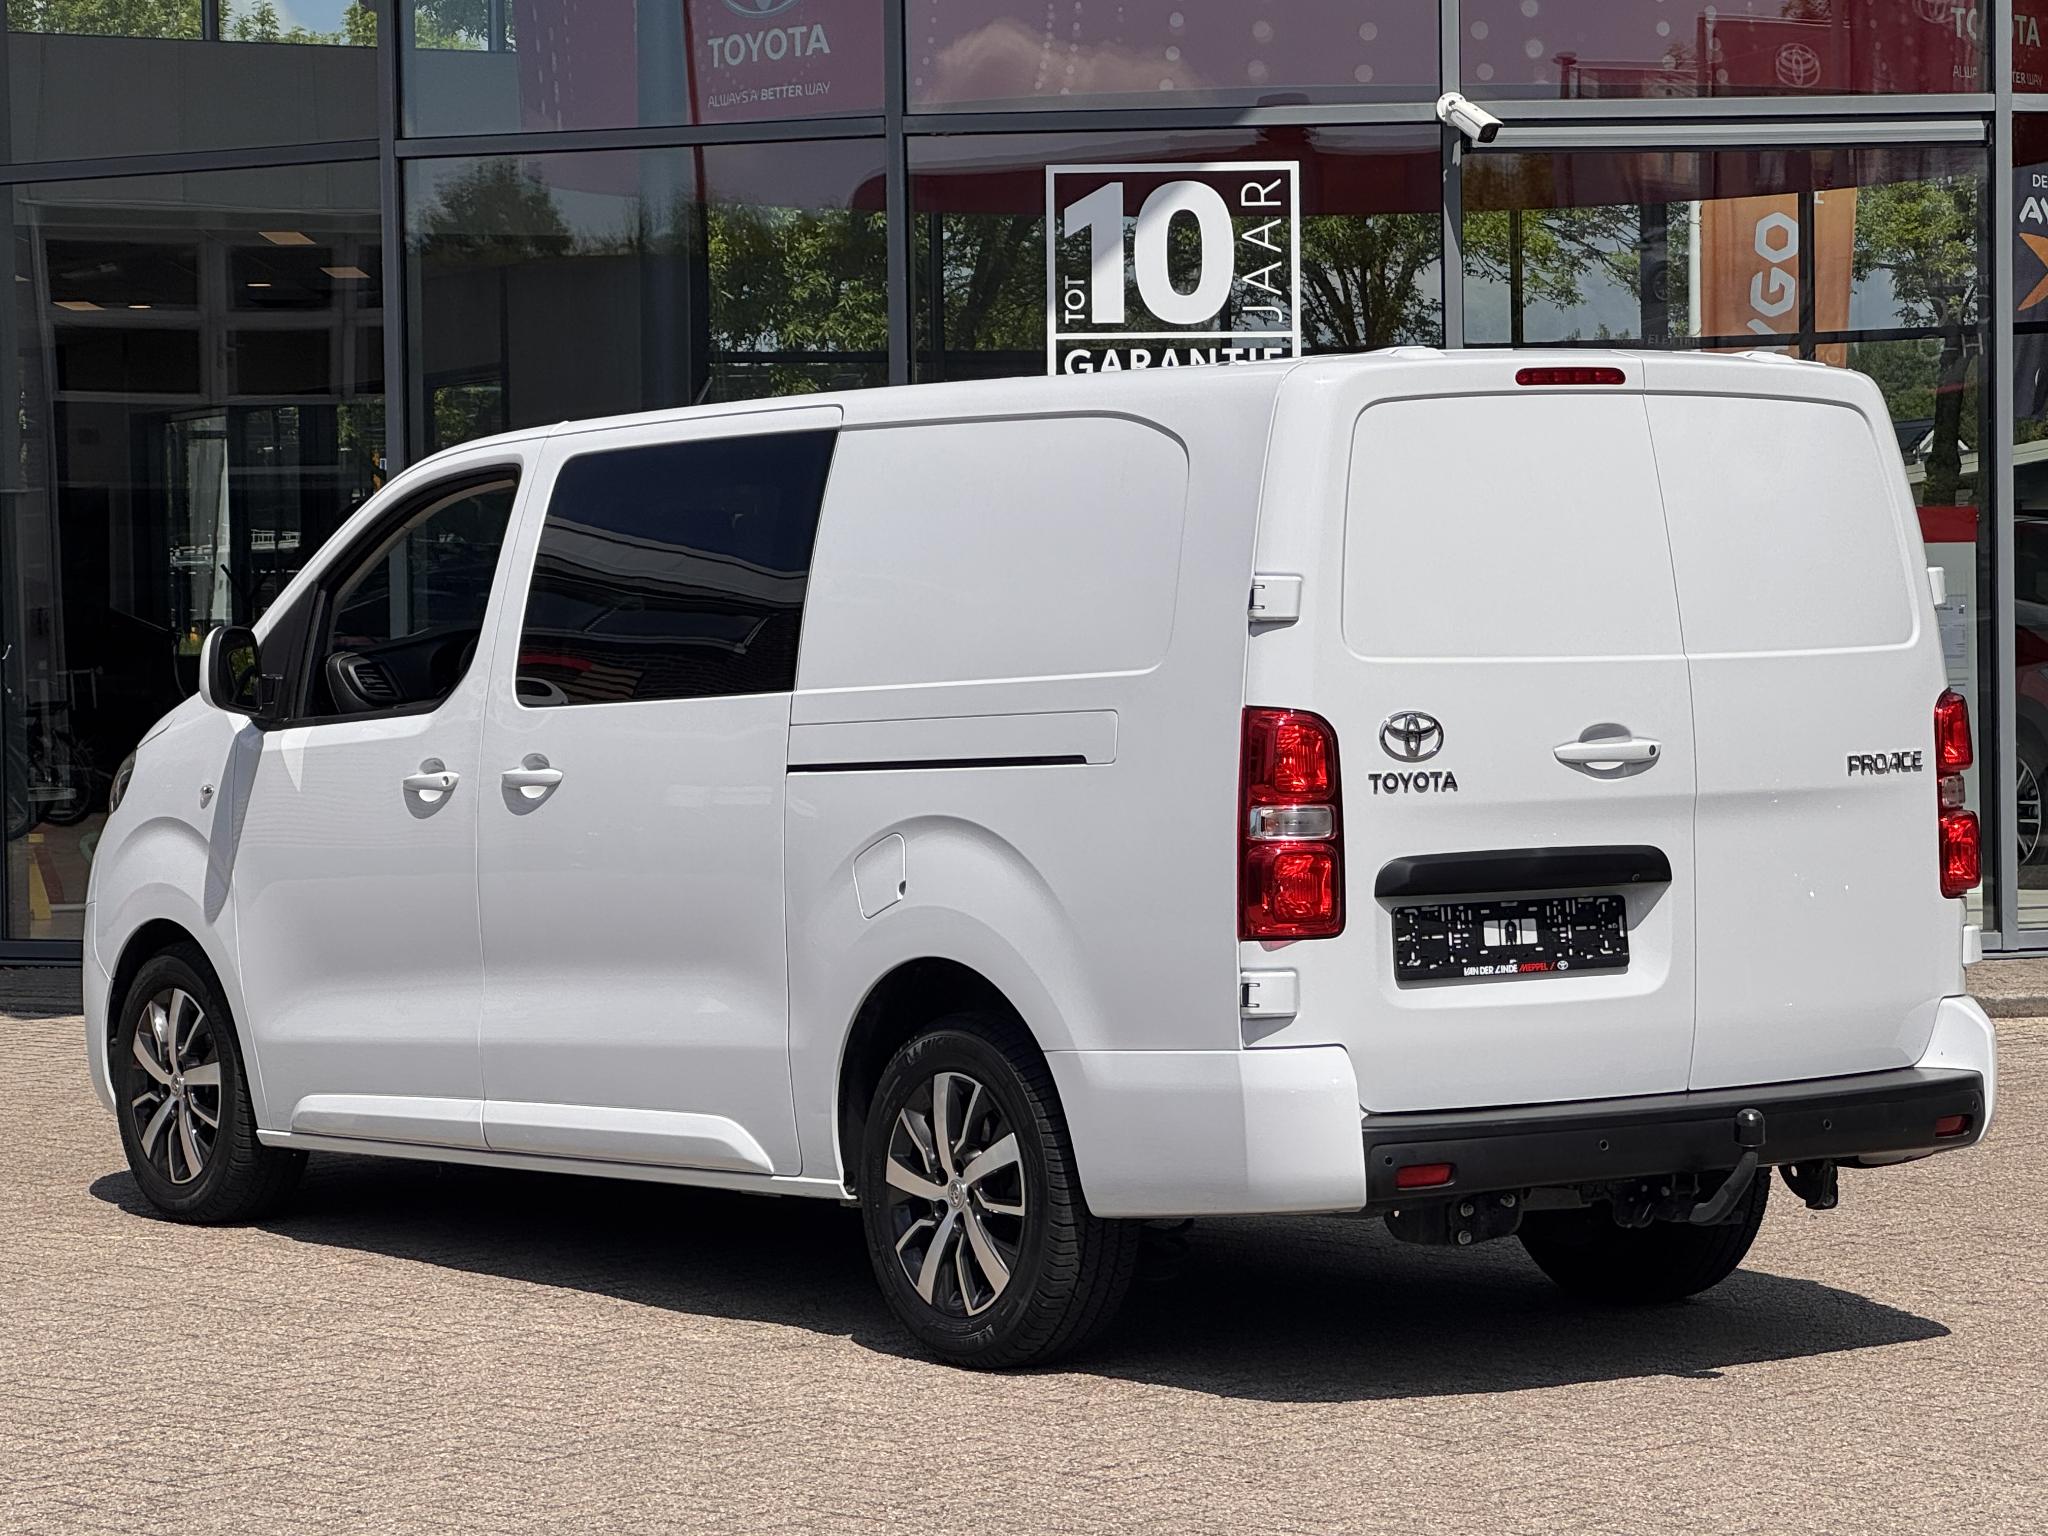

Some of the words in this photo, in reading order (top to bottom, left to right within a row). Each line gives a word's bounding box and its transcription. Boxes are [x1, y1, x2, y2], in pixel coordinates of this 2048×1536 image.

[707, 23, 831, 68] TOYOTA
[708, 90, 749, 108] ALWAYS
[748, 89, 759, 102] A
[760, 84, 803, 101] BETTER
[804, 80, 831, 96] WAY
[1064, 180, 1235, 325] 10
[1240, 178, 1283, 323] JAAR
[1064, 275, 1086, 324] TOT
[1846, 750, 1924, 777] PROACE
[1367, 770, 1459, 795] TOYOTA
[1463, 966, 1479, 977] VAN
[1479, 965, 1494, 976] DER
[1494, 963, 1518, 975] LINDE
[1519, 961, 1549, 973] MEPPEL
